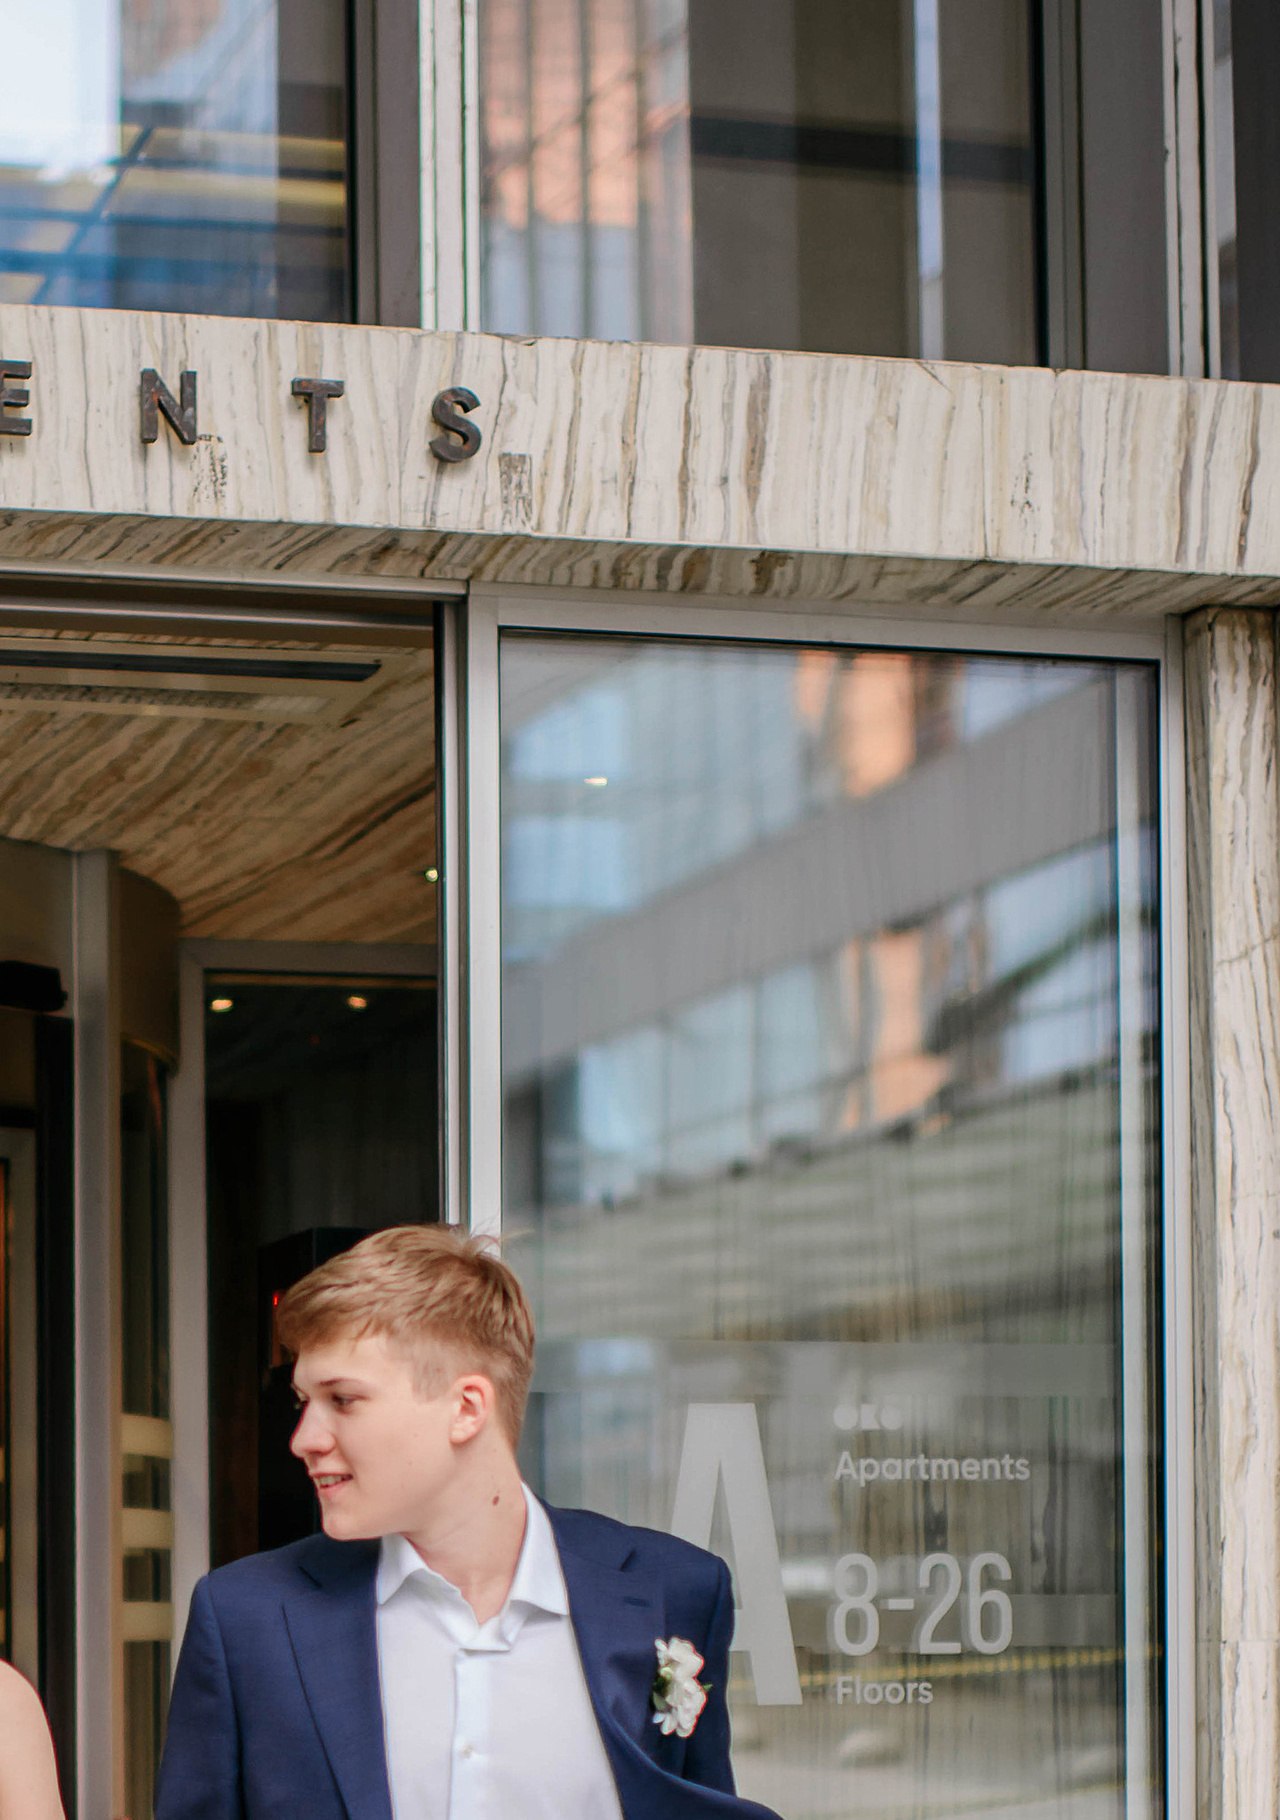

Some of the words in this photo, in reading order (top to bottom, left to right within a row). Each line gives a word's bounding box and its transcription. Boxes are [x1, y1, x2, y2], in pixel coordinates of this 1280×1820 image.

[833, 1450, 1032, 1488] Apartments
[669, 1402, 803, 1705] A
[832, 1552, 1014, 1657] 8-26
[834, 1674, 934, 1705] Floors
